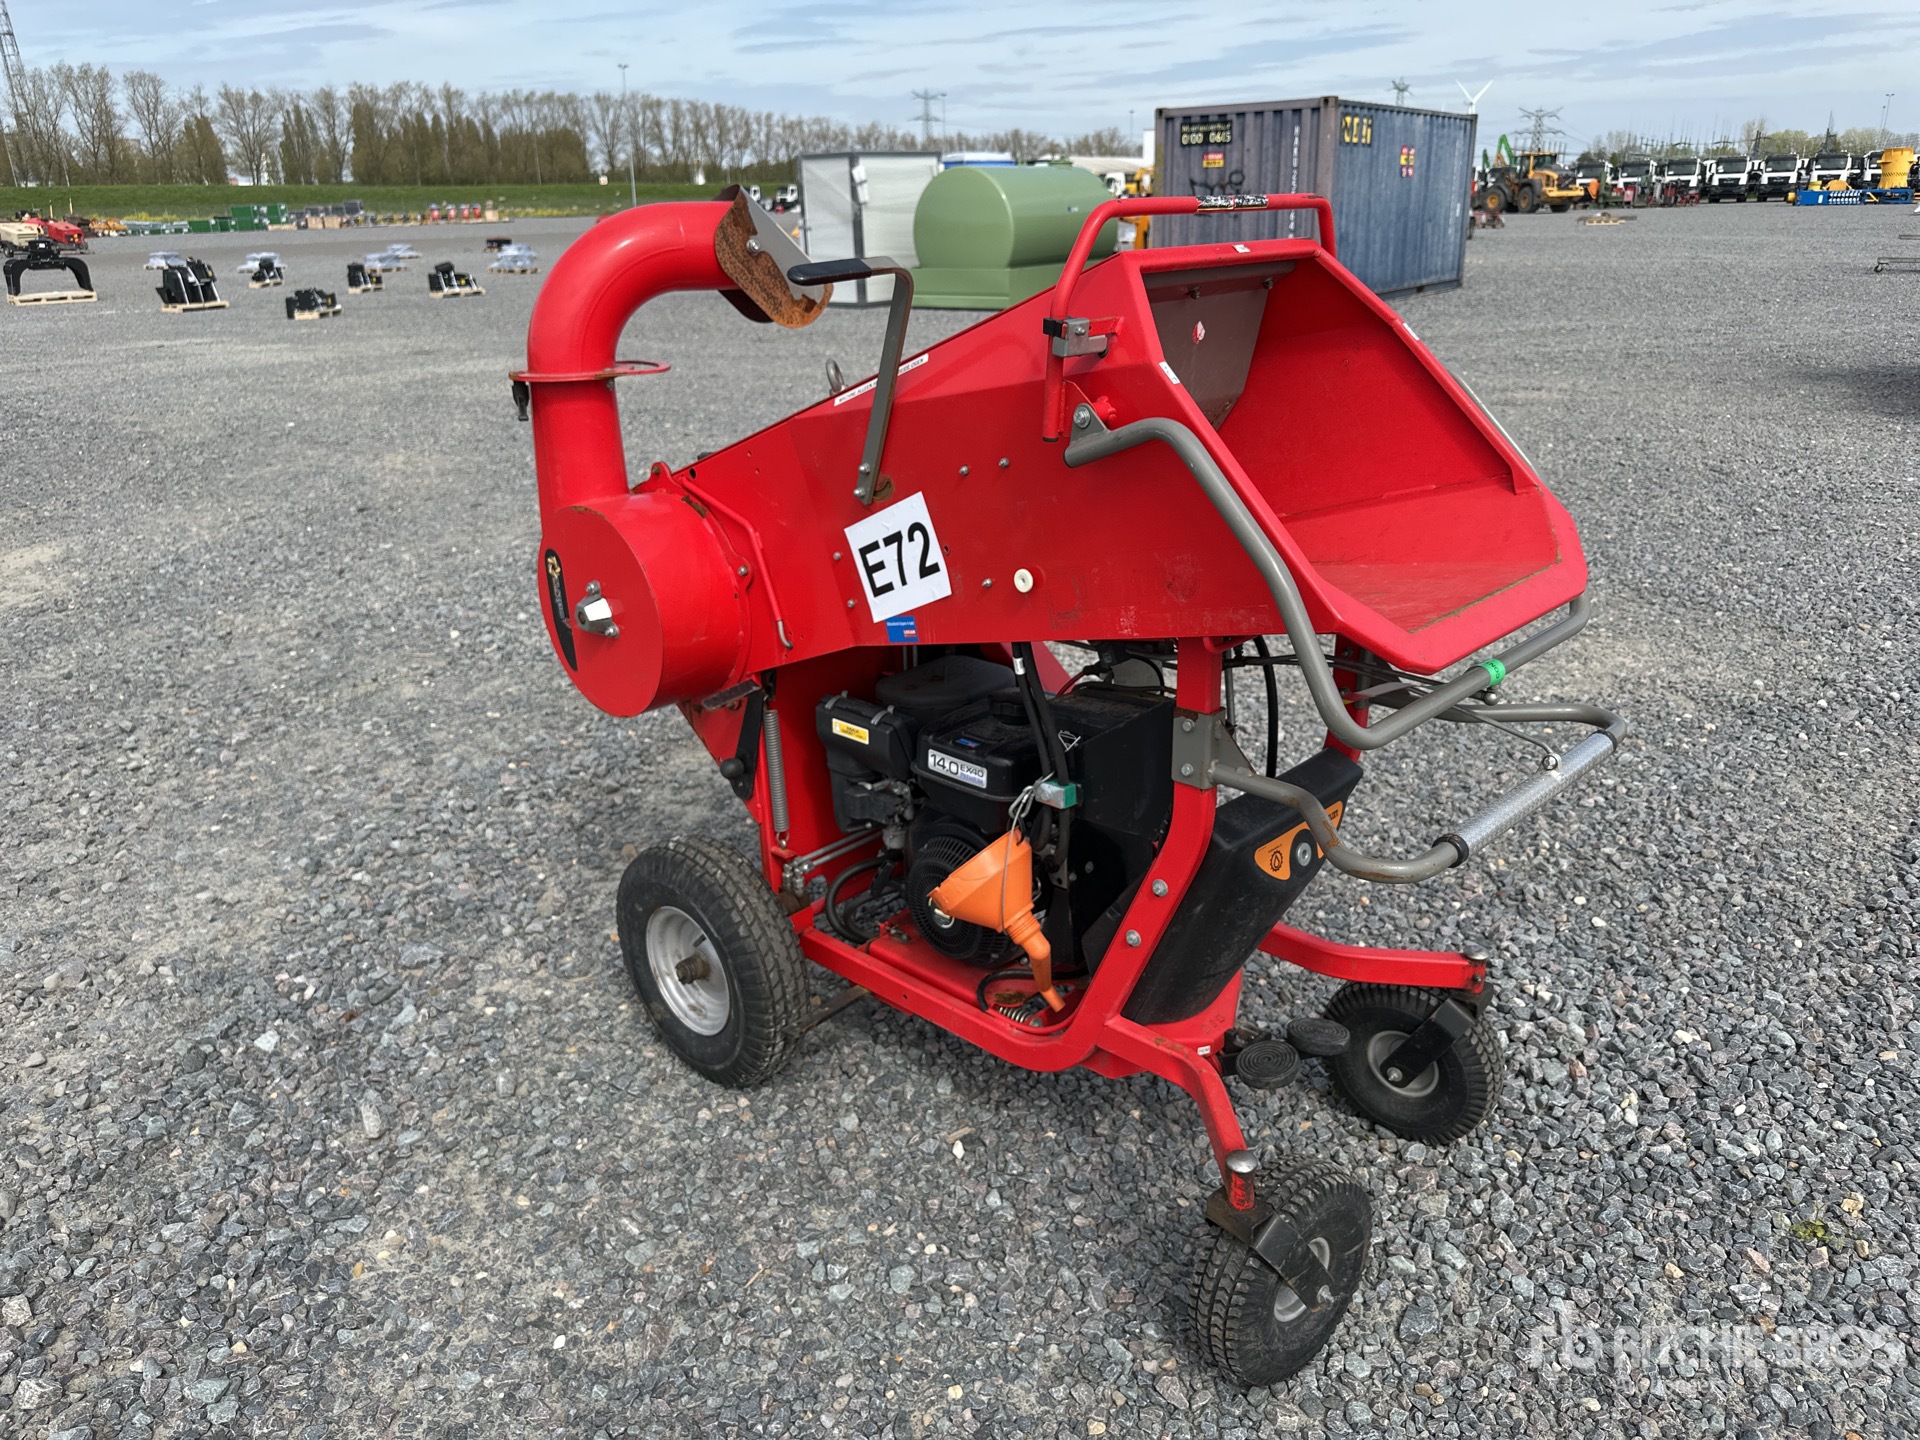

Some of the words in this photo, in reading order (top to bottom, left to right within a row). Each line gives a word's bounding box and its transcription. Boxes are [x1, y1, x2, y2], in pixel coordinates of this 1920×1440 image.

[858, 521, 941, 598] E72
[930, 753, 959, 776] 14.0
[960, 764, 984, 778] EX40
